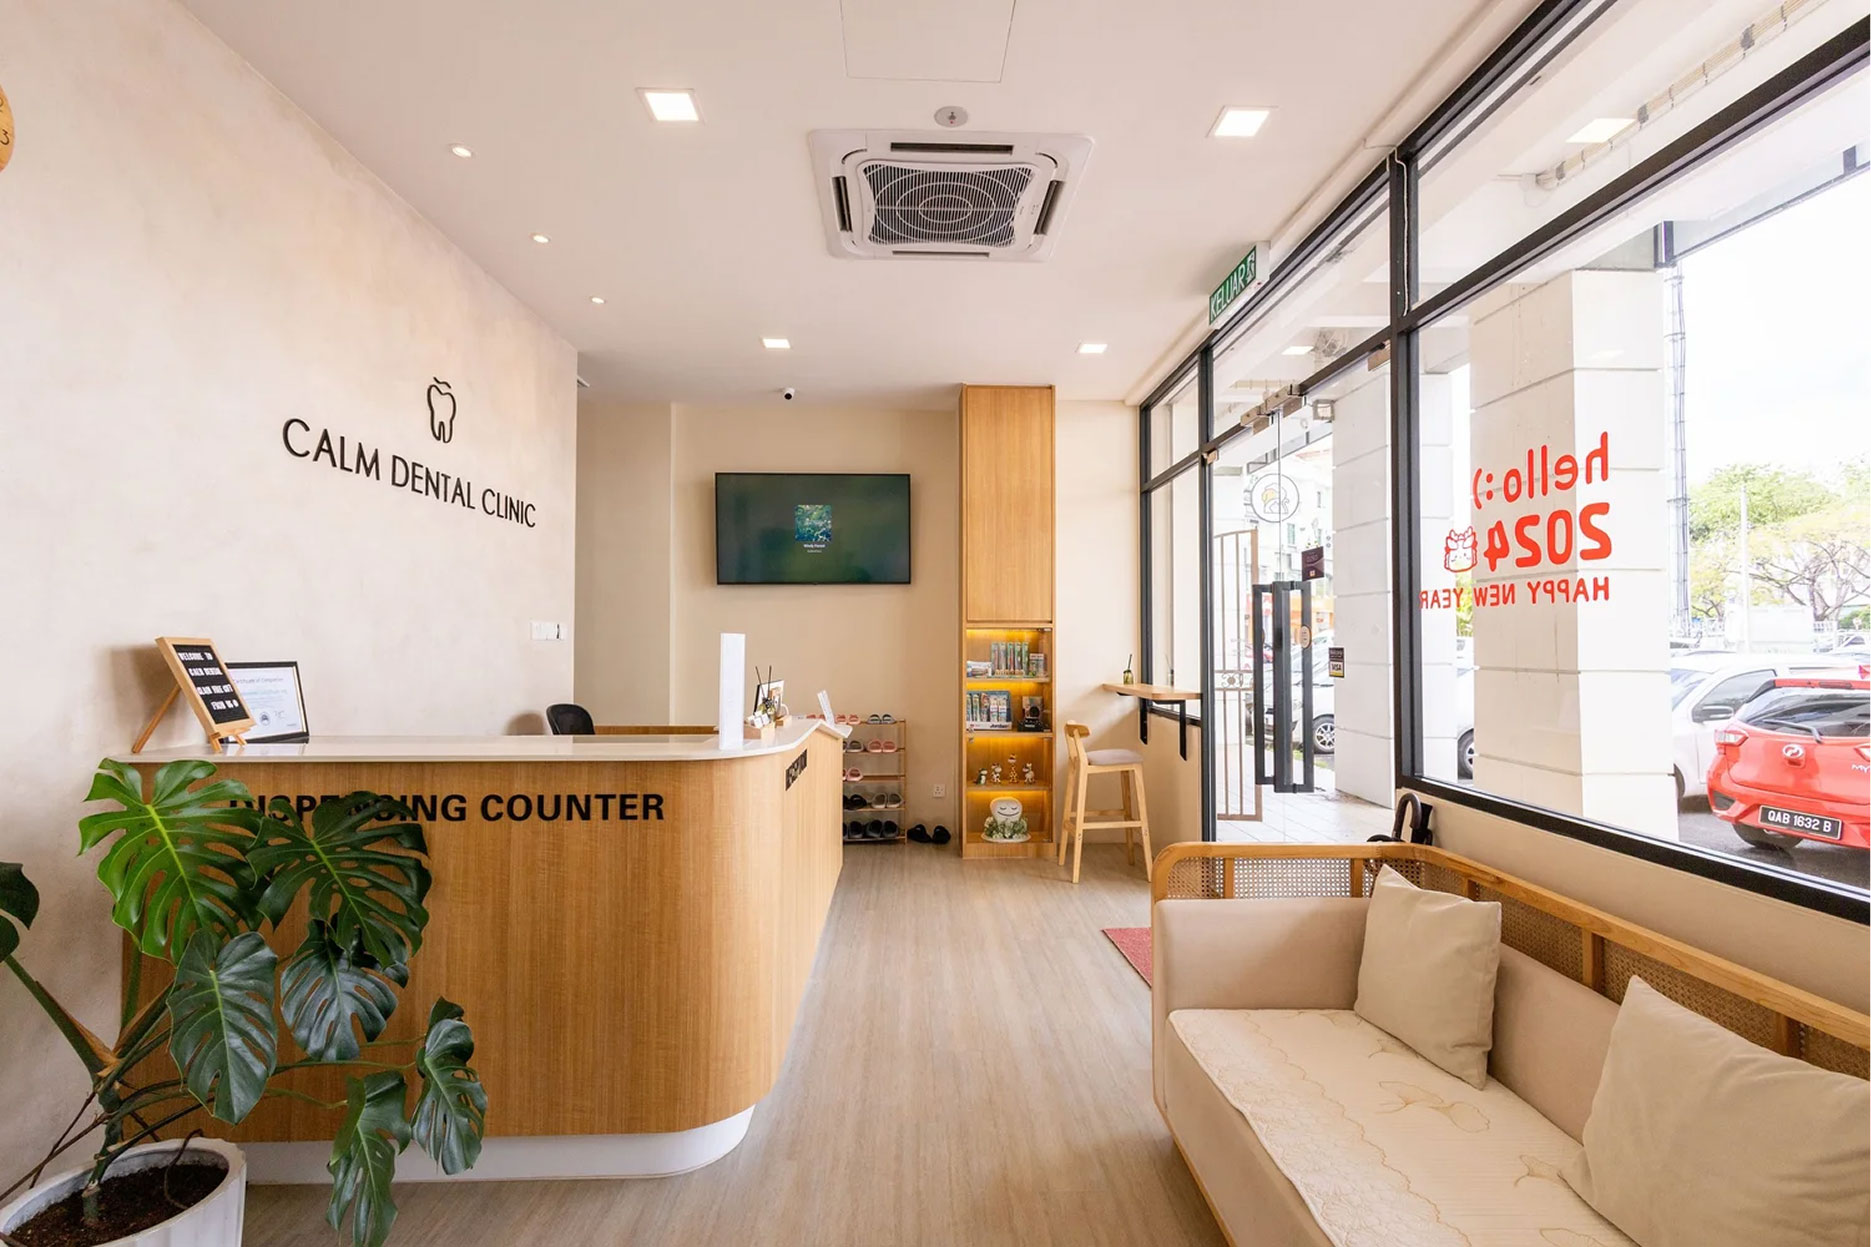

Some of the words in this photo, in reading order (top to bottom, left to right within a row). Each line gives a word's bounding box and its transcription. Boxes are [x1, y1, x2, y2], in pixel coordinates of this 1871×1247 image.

[1210, 263, 1246, 322] KELUAR
[282, 418, 380, 481] CALM
[391, 454, 476, 510] DENTAL
[481, 488, 536, 528] CLINIC
[480, 794, 665, 822] COUNTER
[1767, 810, 1790, 824] QAB
[1793, 814, 1820, 830] 1632
[1823, 820, 1832, 833] B
